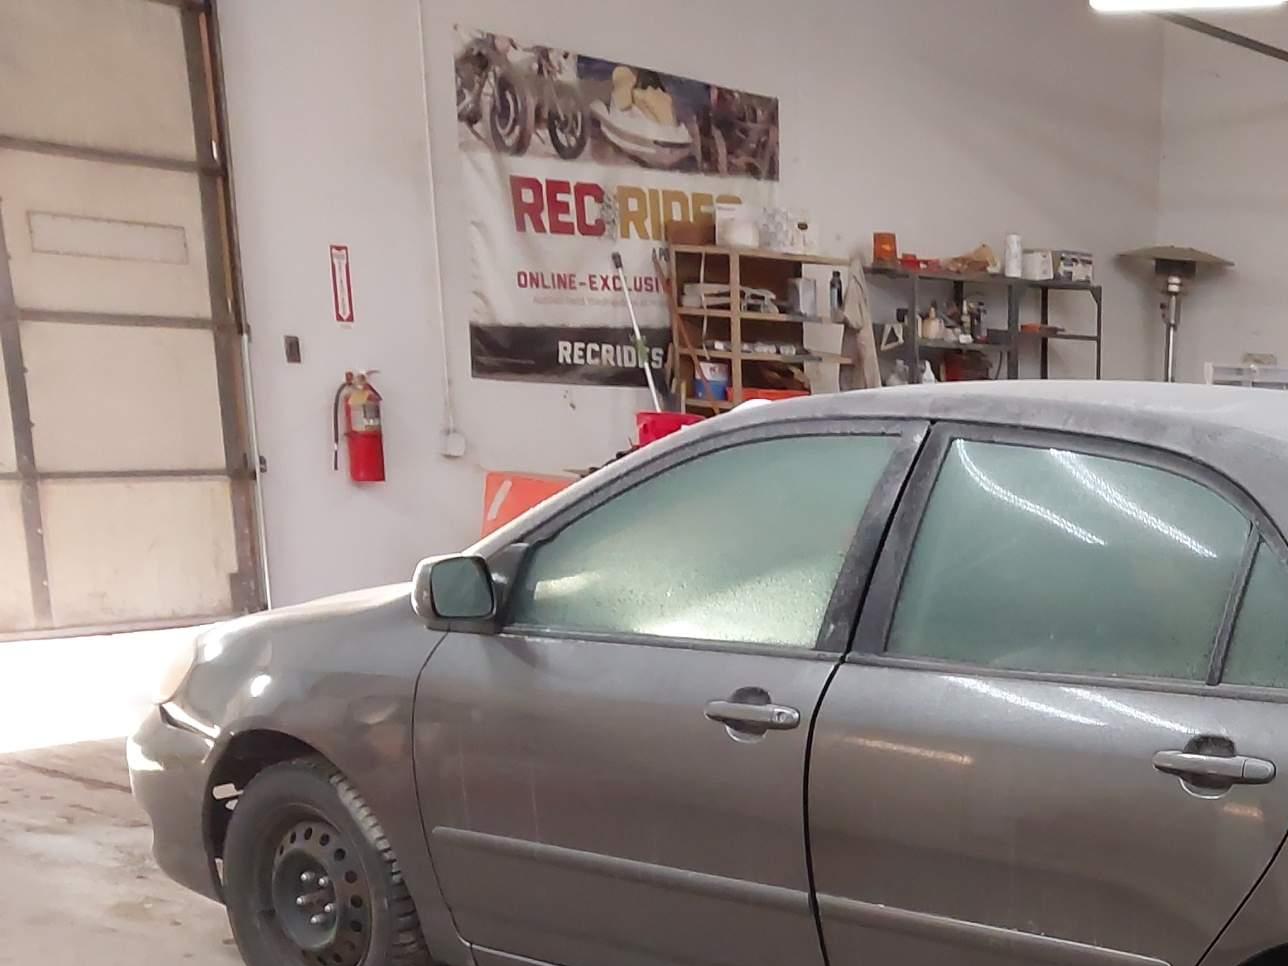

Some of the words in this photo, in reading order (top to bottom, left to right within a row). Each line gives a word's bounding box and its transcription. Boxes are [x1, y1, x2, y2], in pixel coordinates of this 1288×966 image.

[510, 175, 606, 236] REC
[616, 185, 742, 242] RIDE
[517, 271, 660, 294] ONLINE-EXCLUSI
